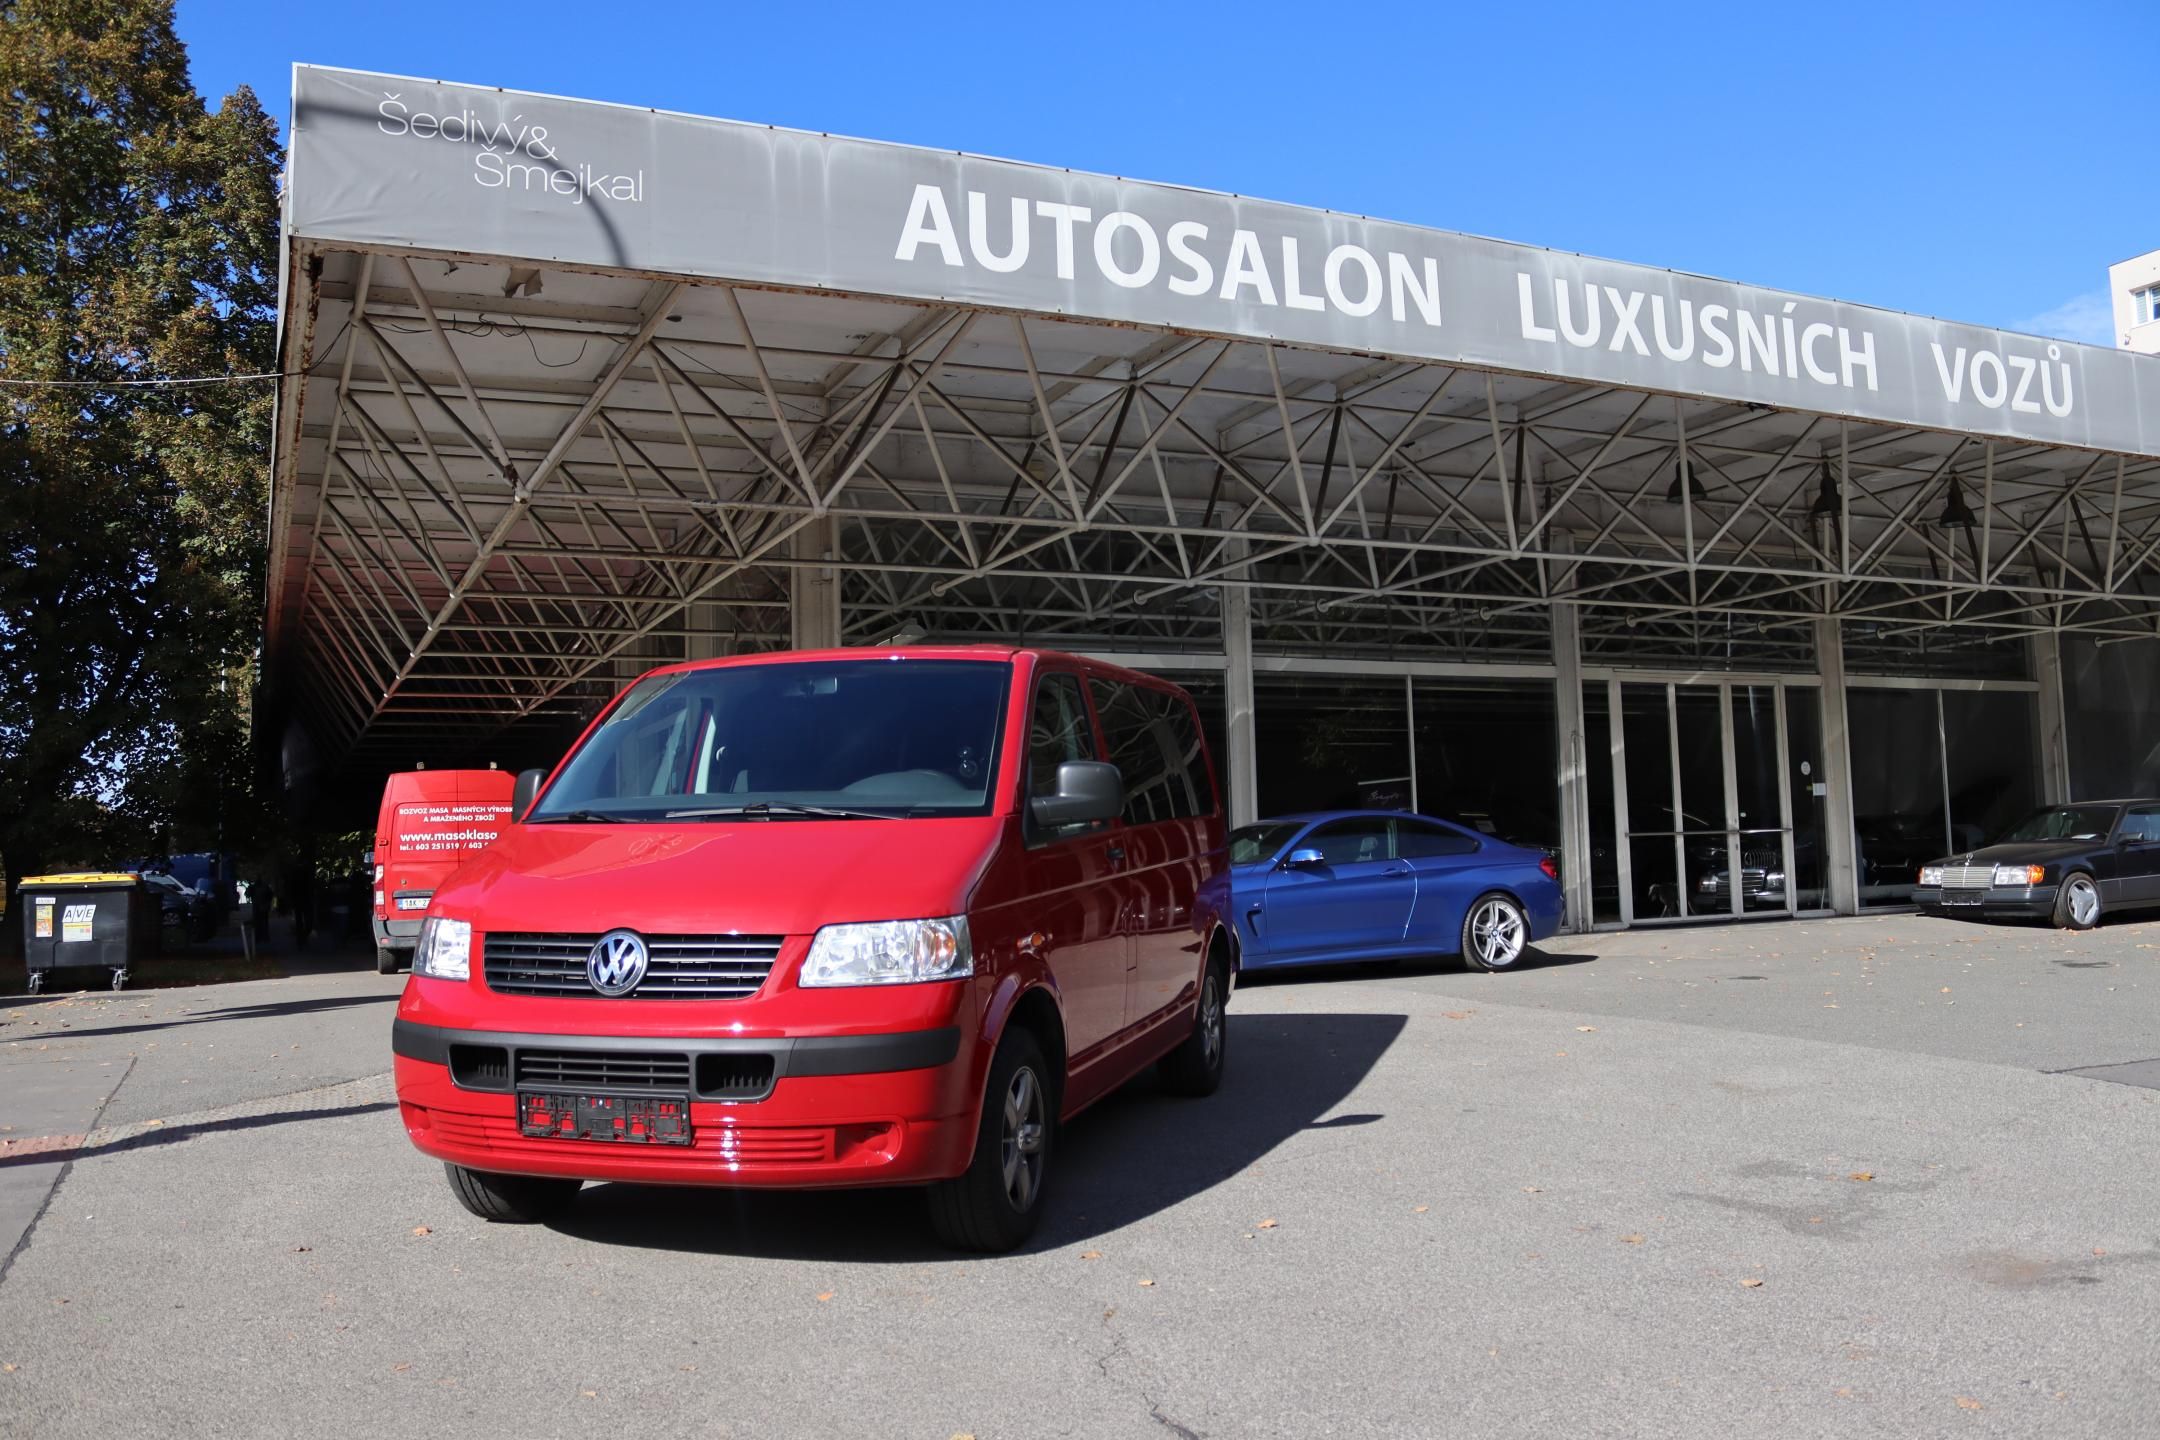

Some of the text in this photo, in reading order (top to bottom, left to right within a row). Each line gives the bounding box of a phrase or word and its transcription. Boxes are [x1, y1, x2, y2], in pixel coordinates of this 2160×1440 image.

[474, 143, 643, 205] Šmejkal
[894, 183, 2073, 418] AUTOSALON LUXUSNÍCH VOZŮ
[452, 805, 486, 813] MASNÝCH
[430, 814, 473, 822] MRAŽENÉHO
[475, 813, 495, 821] ZBOŽÍ
[65, 908, 94, 919] AVE
